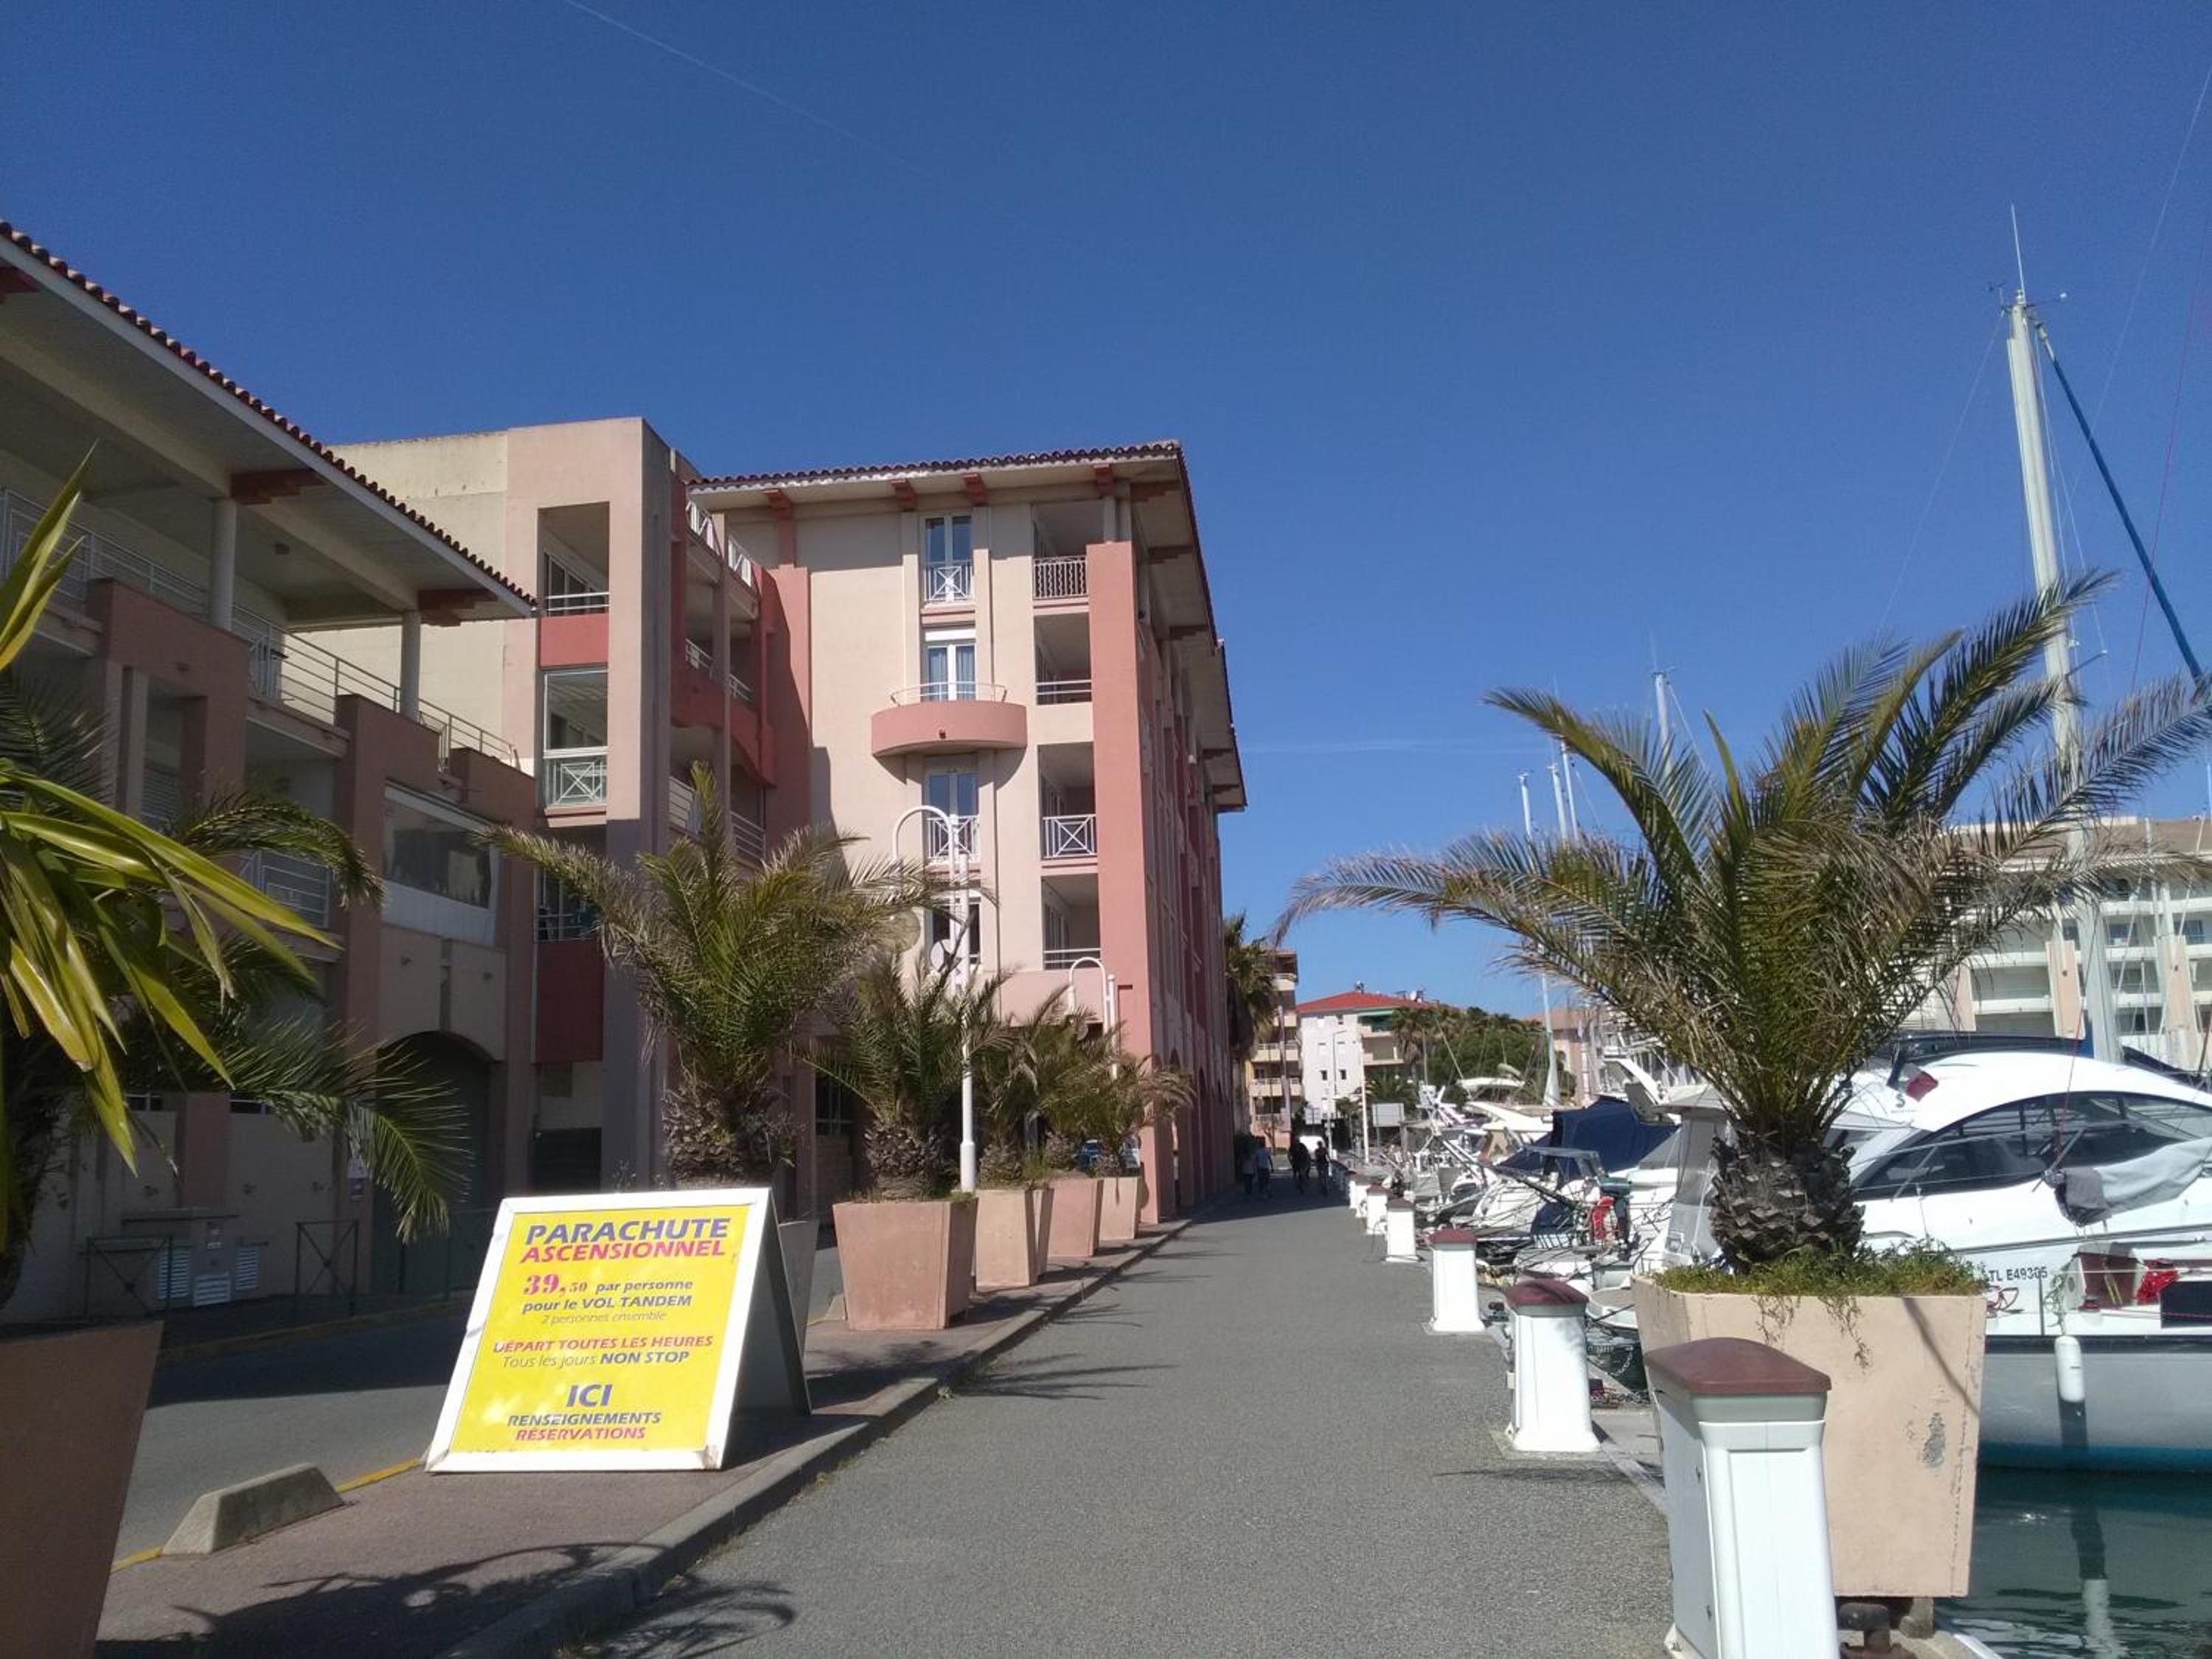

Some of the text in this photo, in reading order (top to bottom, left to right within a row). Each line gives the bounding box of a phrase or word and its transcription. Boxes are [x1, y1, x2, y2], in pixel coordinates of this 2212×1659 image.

[525, 1217, 731, 1245] PARACHUTE
[519, 1239, 725, 1264] ASCENSIONNEL
[595, 1283, 620, 1295] par
[623, 1281, 694, 1294] personne
[522, 1294, 692, 1315] pour le VOL TANDEM
[550, 1313, 610, 1326] personnes
[559, 1338, 617, 1351] TOUTES
[621, 1336, 648, 1349] LES
[651, 1335, 714, 1348] HEURES
[503, 1350, 690, 1369] Tous les jours NON STOP
[566, 1383, 613, 1408] ICI
[507, 1411, 662, 1427] RENSEIGNEMENTS
